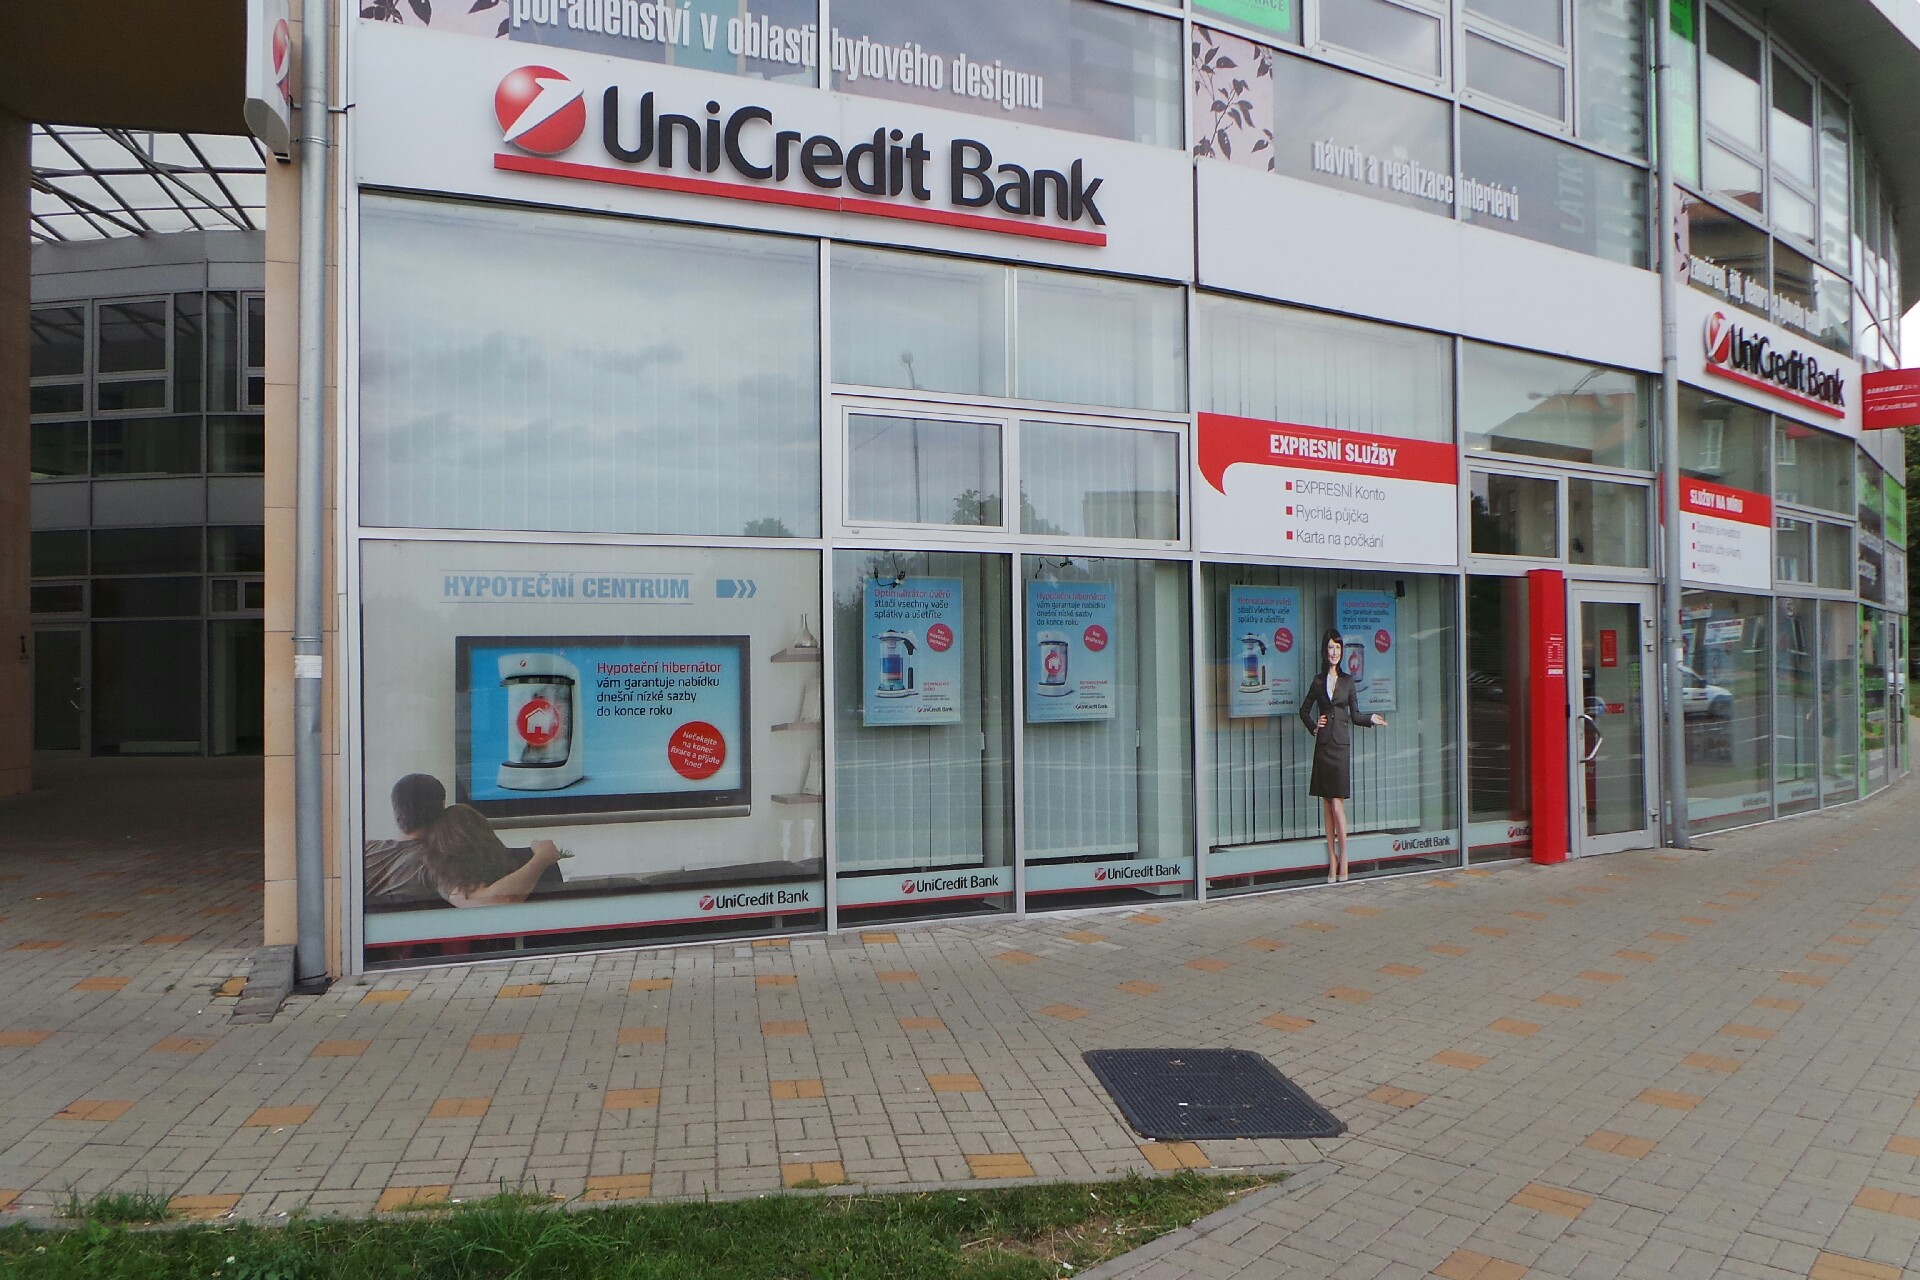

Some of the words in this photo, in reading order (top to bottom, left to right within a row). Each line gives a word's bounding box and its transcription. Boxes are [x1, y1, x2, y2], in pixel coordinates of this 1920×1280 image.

[700, 13, 718, 50] v
[727, 13, 817, 67] oblasti
[832, 28, 944, 90] bytového
[952, 53, 1044, 110] designu
[603, 86, 931, 200] UniCredit
[951, 139, 1107, 226] Bank
[1315, 138, 1363, 181] návrh
[1368, 157, 1378, 184] a
[1383, 159, 1453, 204] realizace
[1731, 324, 1804, 393] UniCredit
[1808, 357, 1845, 407] Bank
[1270, 433, 1341, 460] EXPRESNÍ
[1345, 443, 1397, 466] SLUŽBY
[1296, 480, 1352, 498] EXPRESNÍ
[1355, 486, 1386, 501] Konto
[1296, 504, 1332, 521] Rychlá
[1335, 507, 1369, 525] půjčka
[1296, 529, 1325, 544] Karta
[1328, 535, 1341, 545] na
[1344, 534, 1385, 549] počkání
[443, 572, 574, 597] HYPOTEČNÍ
[582, 578, 689, 599] CENTRUM
[597, 661, 659, 675] Hypoteční
[662, 661, 721, 673] hibernátor
[597, 677, 620, 688] vám
[624, 677, 675, 690] garantuje
[679, 675, 720, 687] nabídku
[597, 690, 634, 702] dnešní
[637, 690, 664, 701] nízké
[667, 690, 697, 703] sazby
[597, 706, 611, 716] do
[614, 706, 645, 716] konce
[649, 705, 672, 716] roku
[1401, 838, 1432, 850] UniCredit
[1434, 836, 1450, 846] Bank
[1108, 865, 1153, 879] UniCredit
[1155, 864, 1181, 877] Bank
[916, 876, 968, 892] UniCredit
[971, 874, 998, 888] Bank
[716, 892, 774, 908] UniCredit
[777, 889, 809, 904] Bank
